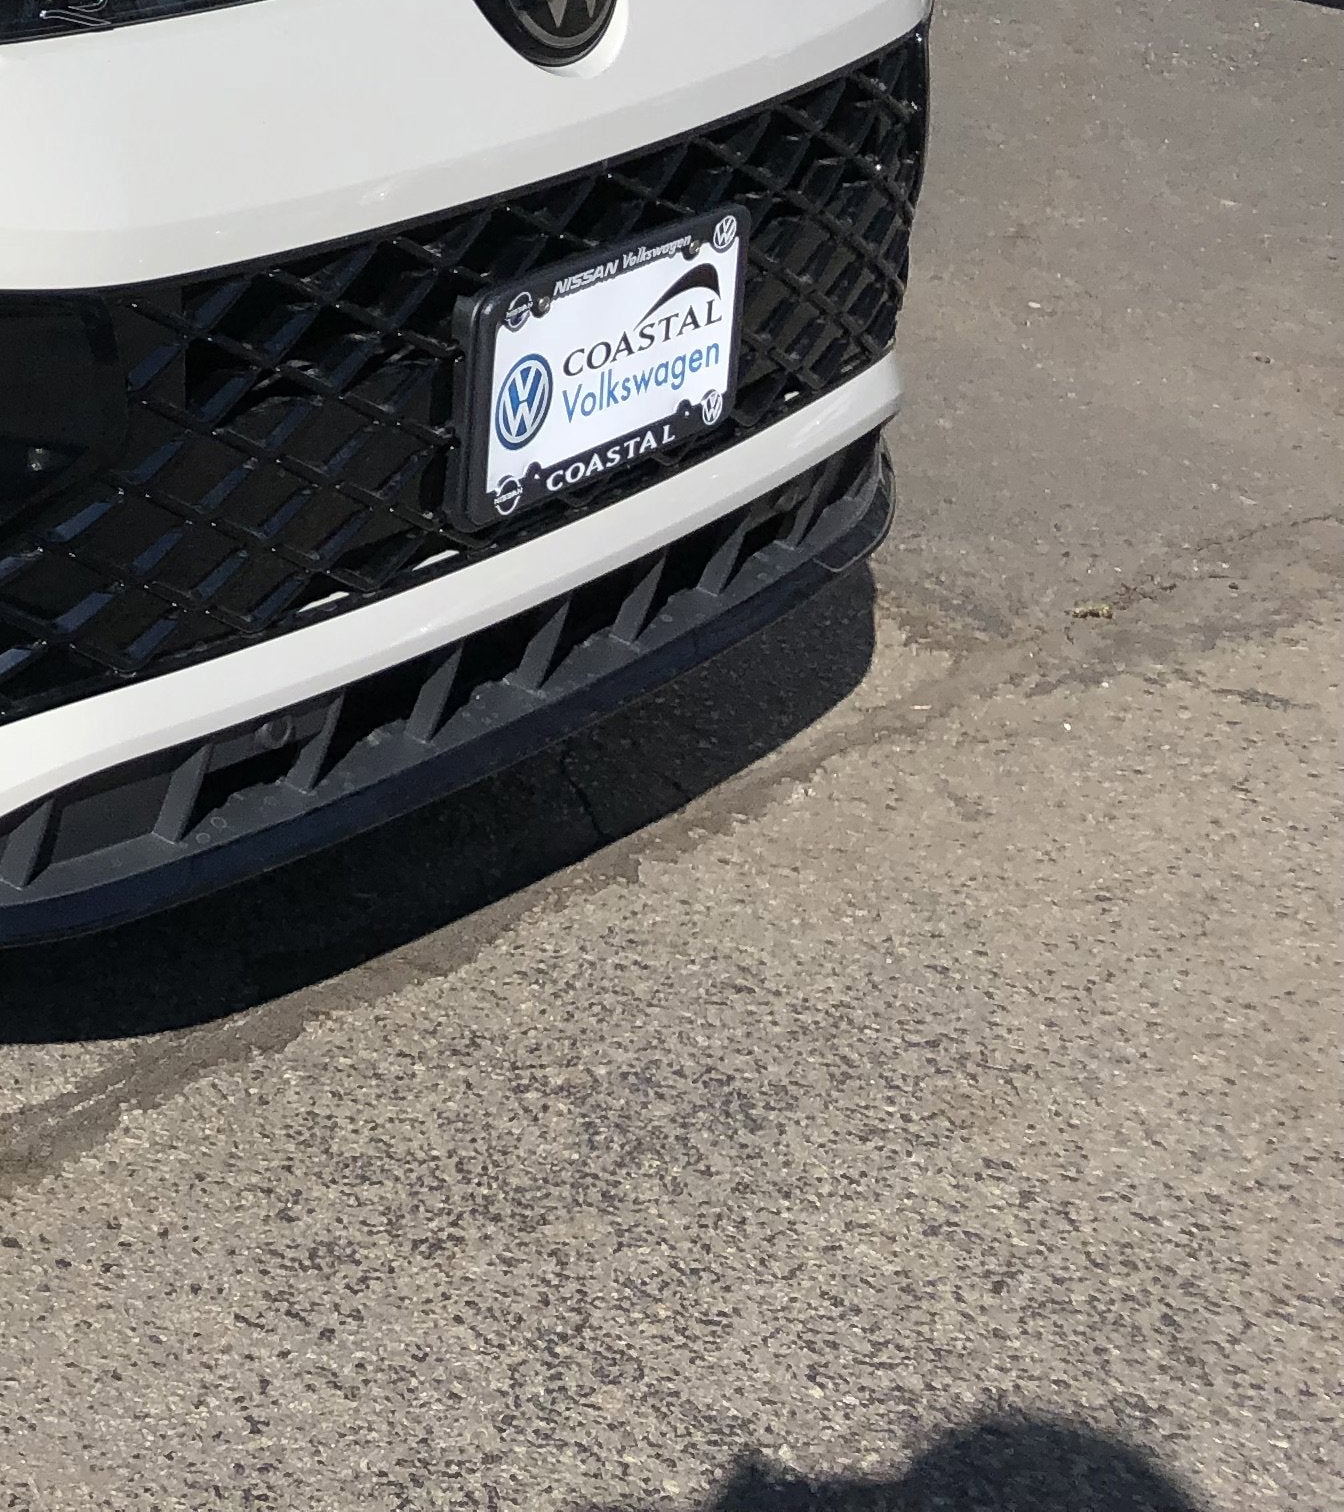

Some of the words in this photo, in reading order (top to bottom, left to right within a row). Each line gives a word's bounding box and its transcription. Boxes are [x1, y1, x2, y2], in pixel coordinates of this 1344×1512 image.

[553, 259, 619, 295] NISSAN
[622, 234, 692, 268] Volkswagen
[562, 298, 722, 377] COASTAL
[562, 342, 720, 423] Volkswagen
[545, 424, 676, 491] COASTAL
